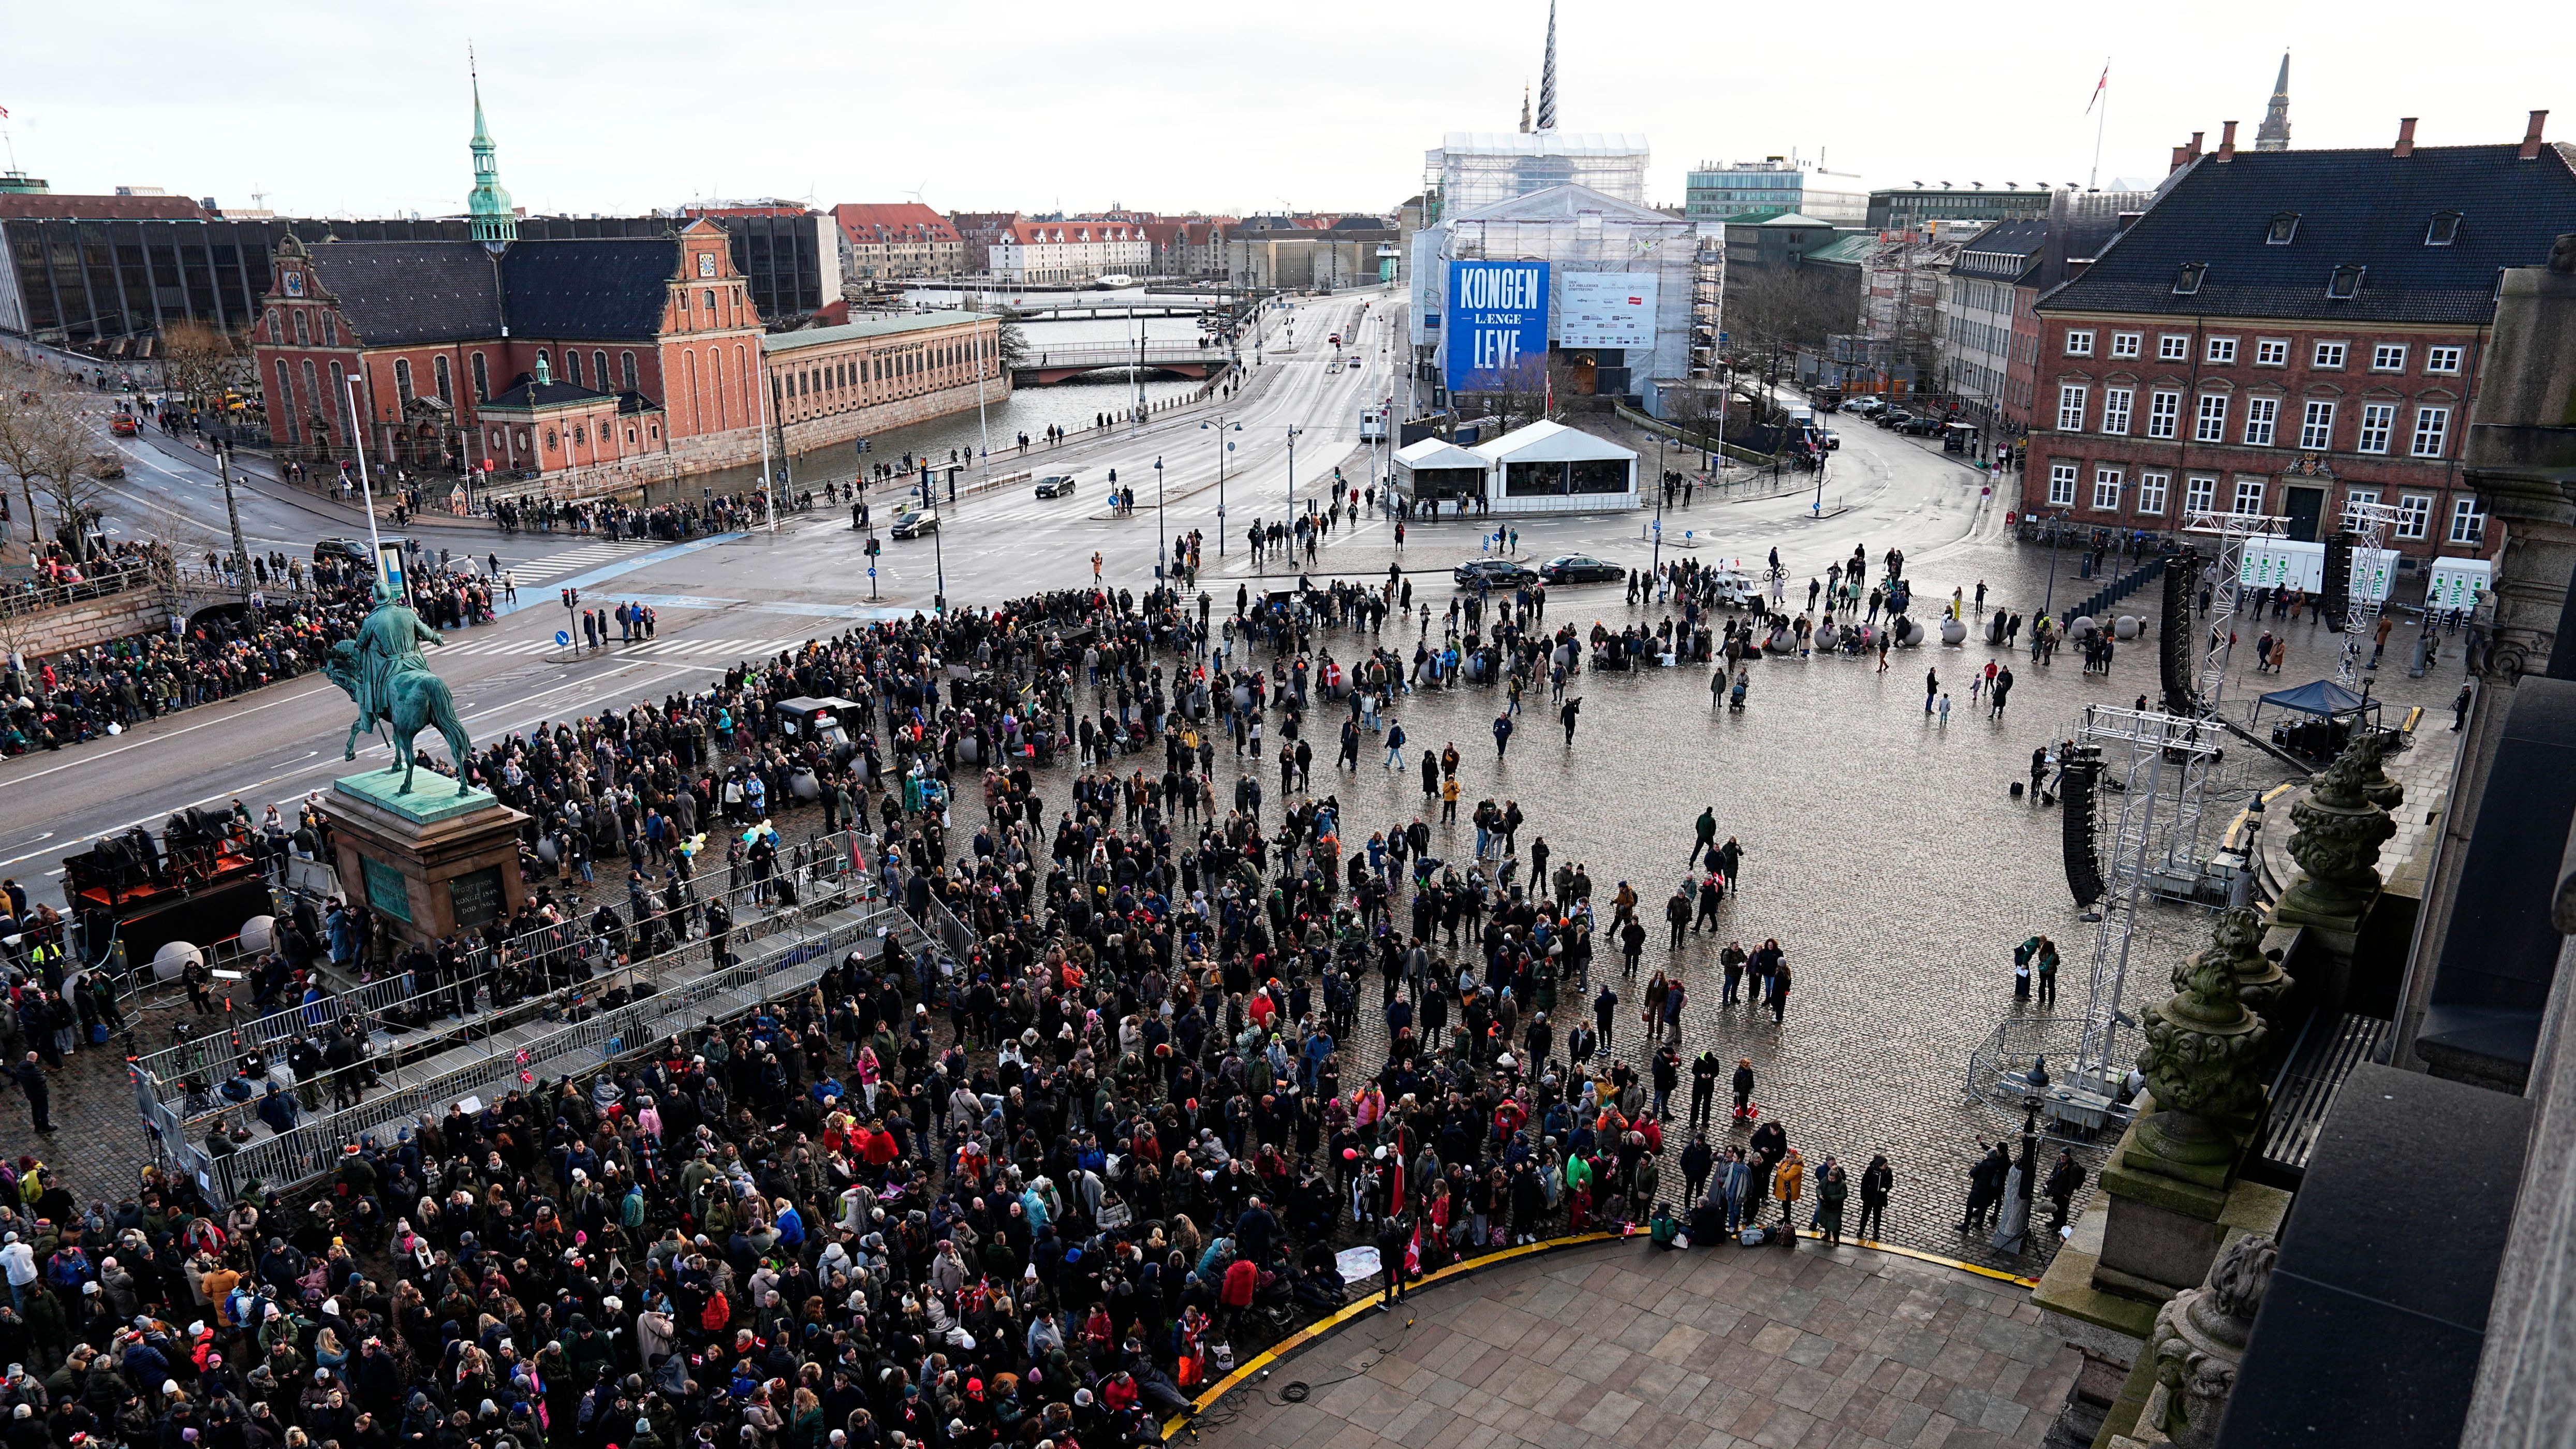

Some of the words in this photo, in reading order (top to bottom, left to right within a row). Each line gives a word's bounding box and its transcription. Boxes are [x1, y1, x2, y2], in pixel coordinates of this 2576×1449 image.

[1461, 268, 1538, 310] KONGEN
[1475, 314, 1522, 325] LÆNGE
[1474, 329, 1521, 369] LEVE
[457, 884, 475, 894] FØDT
[455, 894, 480, 905] KONGE
[462, 905, 476, 915] DØD
